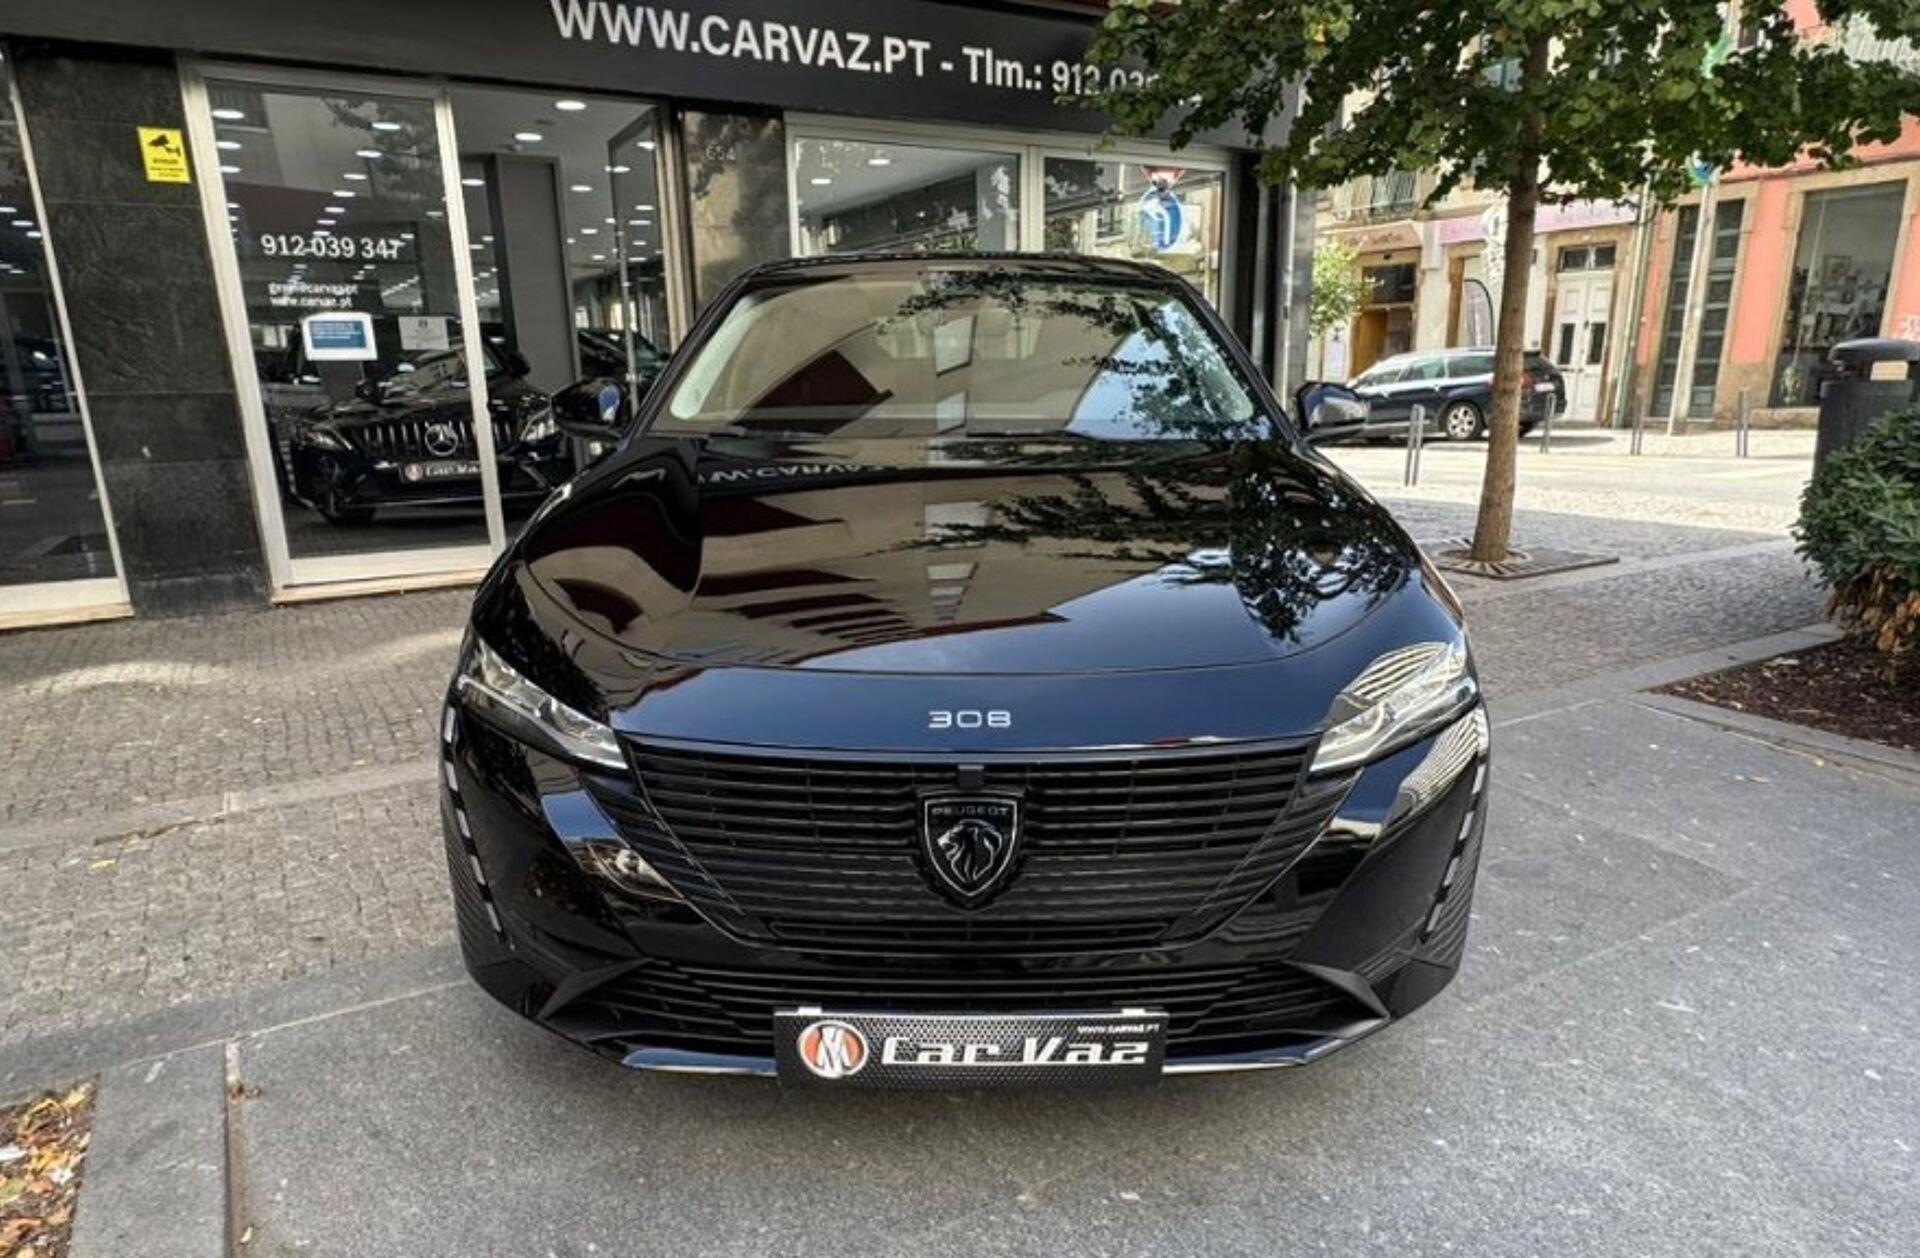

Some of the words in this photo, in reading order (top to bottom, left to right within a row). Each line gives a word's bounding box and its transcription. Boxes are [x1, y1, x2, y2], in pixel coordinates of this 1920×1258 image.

[550, 0, 931, 78] WWW.CARVAZ.PT
[962, 46, 1042, 91] Tlm.:
[260, 233, 306, 257] 912
[311, 236, 356, 258] 039
[928, 710, 1011, 729] 308
[931, 806, 1010, 817] PEUGEOT
[881, 1036, 1000, 1065] Car
[1021, 1036, 1150, 1064] Vaz
